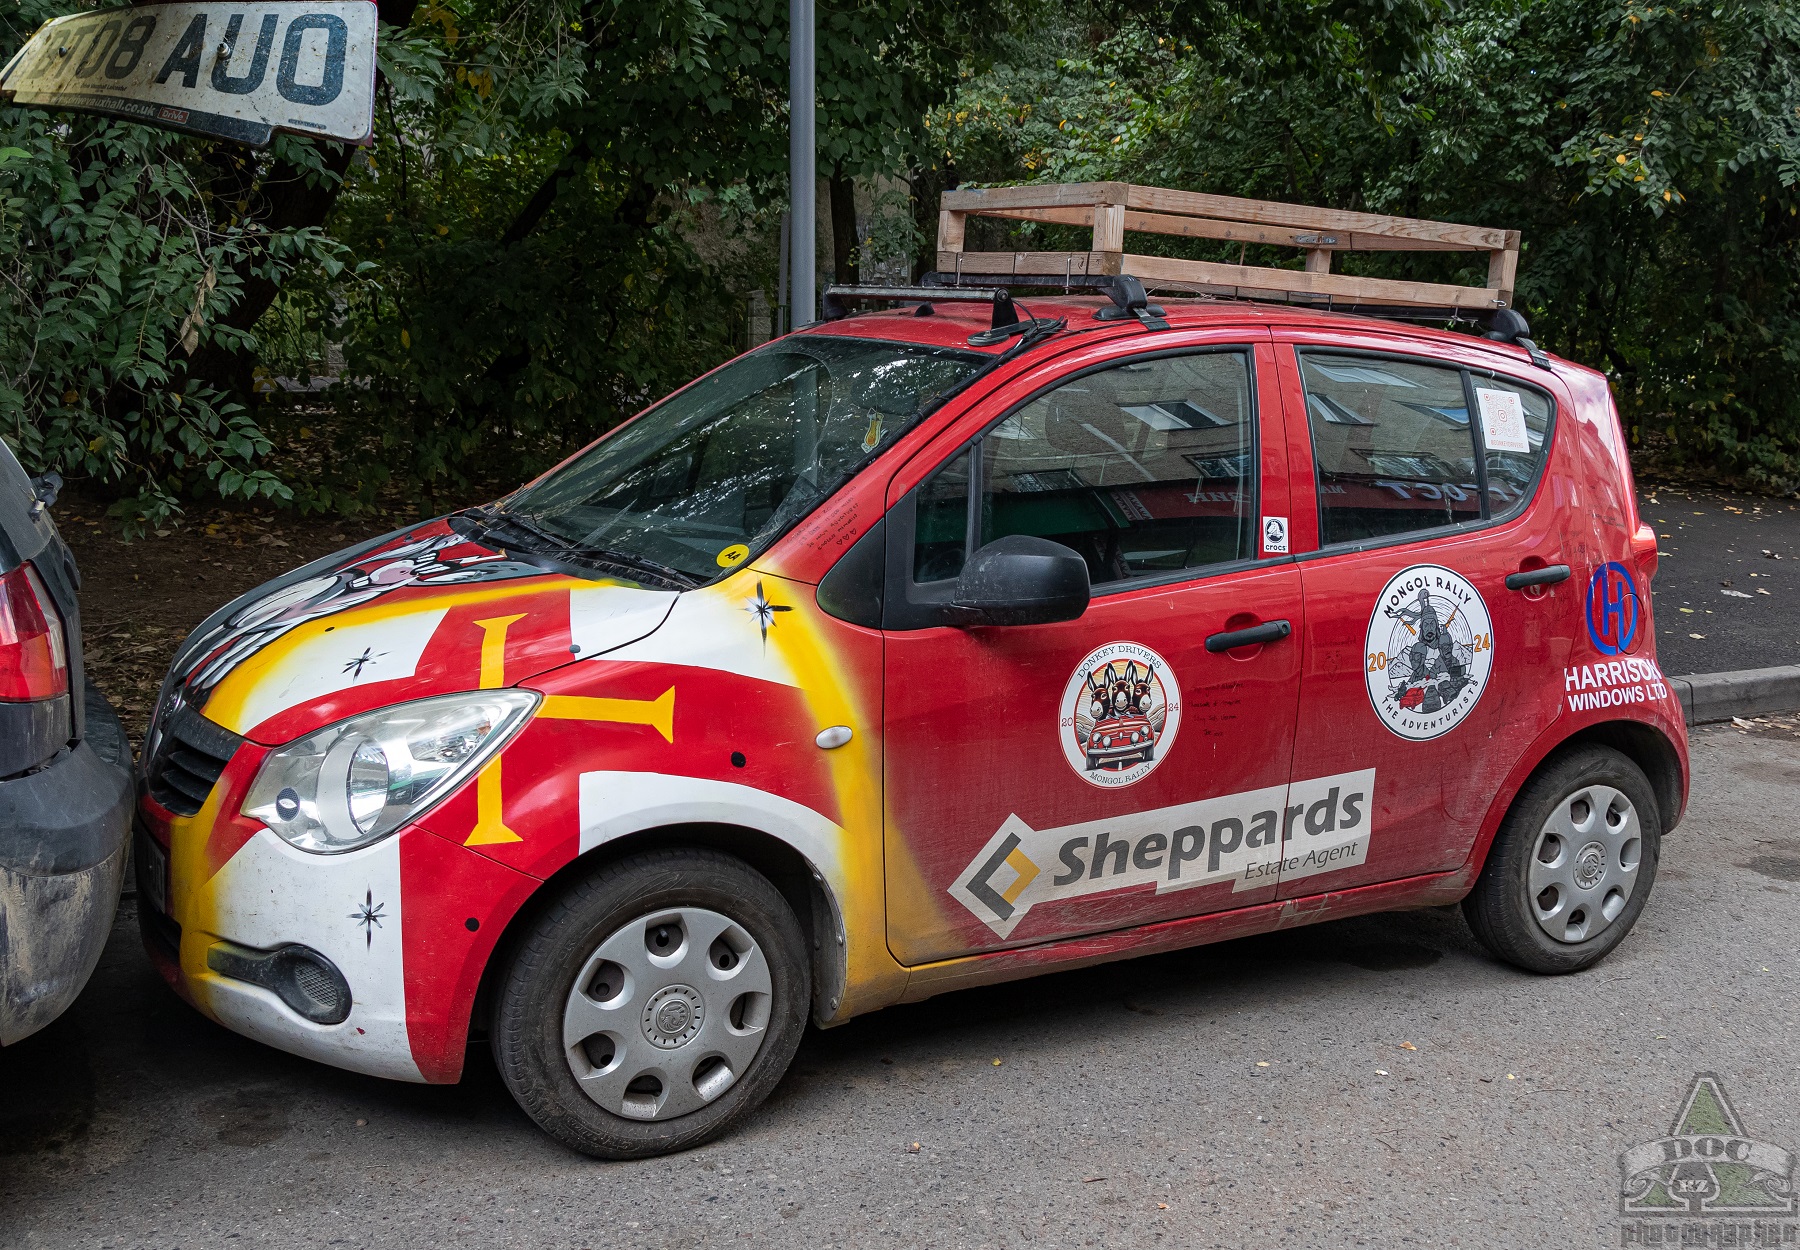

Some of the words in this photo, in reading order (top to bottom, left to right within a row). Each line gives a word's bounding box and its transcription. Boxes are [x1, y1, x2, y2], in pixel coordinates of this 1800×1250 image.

[26, 15, 157, 81] BT08
[155, 13, 348, 106] AUO
[1383, 575, 1431, 619] MONGOL
[1436, 576, 1472, 605] RALLY
[1077, 646, 1115, 679] DONKEY
[1117, 645, 1162, 669] DRIVERS
[1368, 652, 1387, 672] 20
[1474, 633, 1490, 653] 24
[1563, 658, 1663, 692] HARRISON
[1061, 717, 1074, 727] 20
[1168, 702, 1180, 712] 24
[1381, 696, 1398, 720] THE
[1401, 679, 1479, 731] ADVENTURISTS
[1567, 687, 1645, 712] WINDOWS
[1647, 683, 1668, 699] LTD
[1089, 771, 1124, 785] MONGOL
[1124, 762, 1151, 782] RALLY
[1053, 787, 1364, 886] Sheppards
[1244, 856, 1300, 880] Estate
[1301, 841, 1359, 868] Agent
